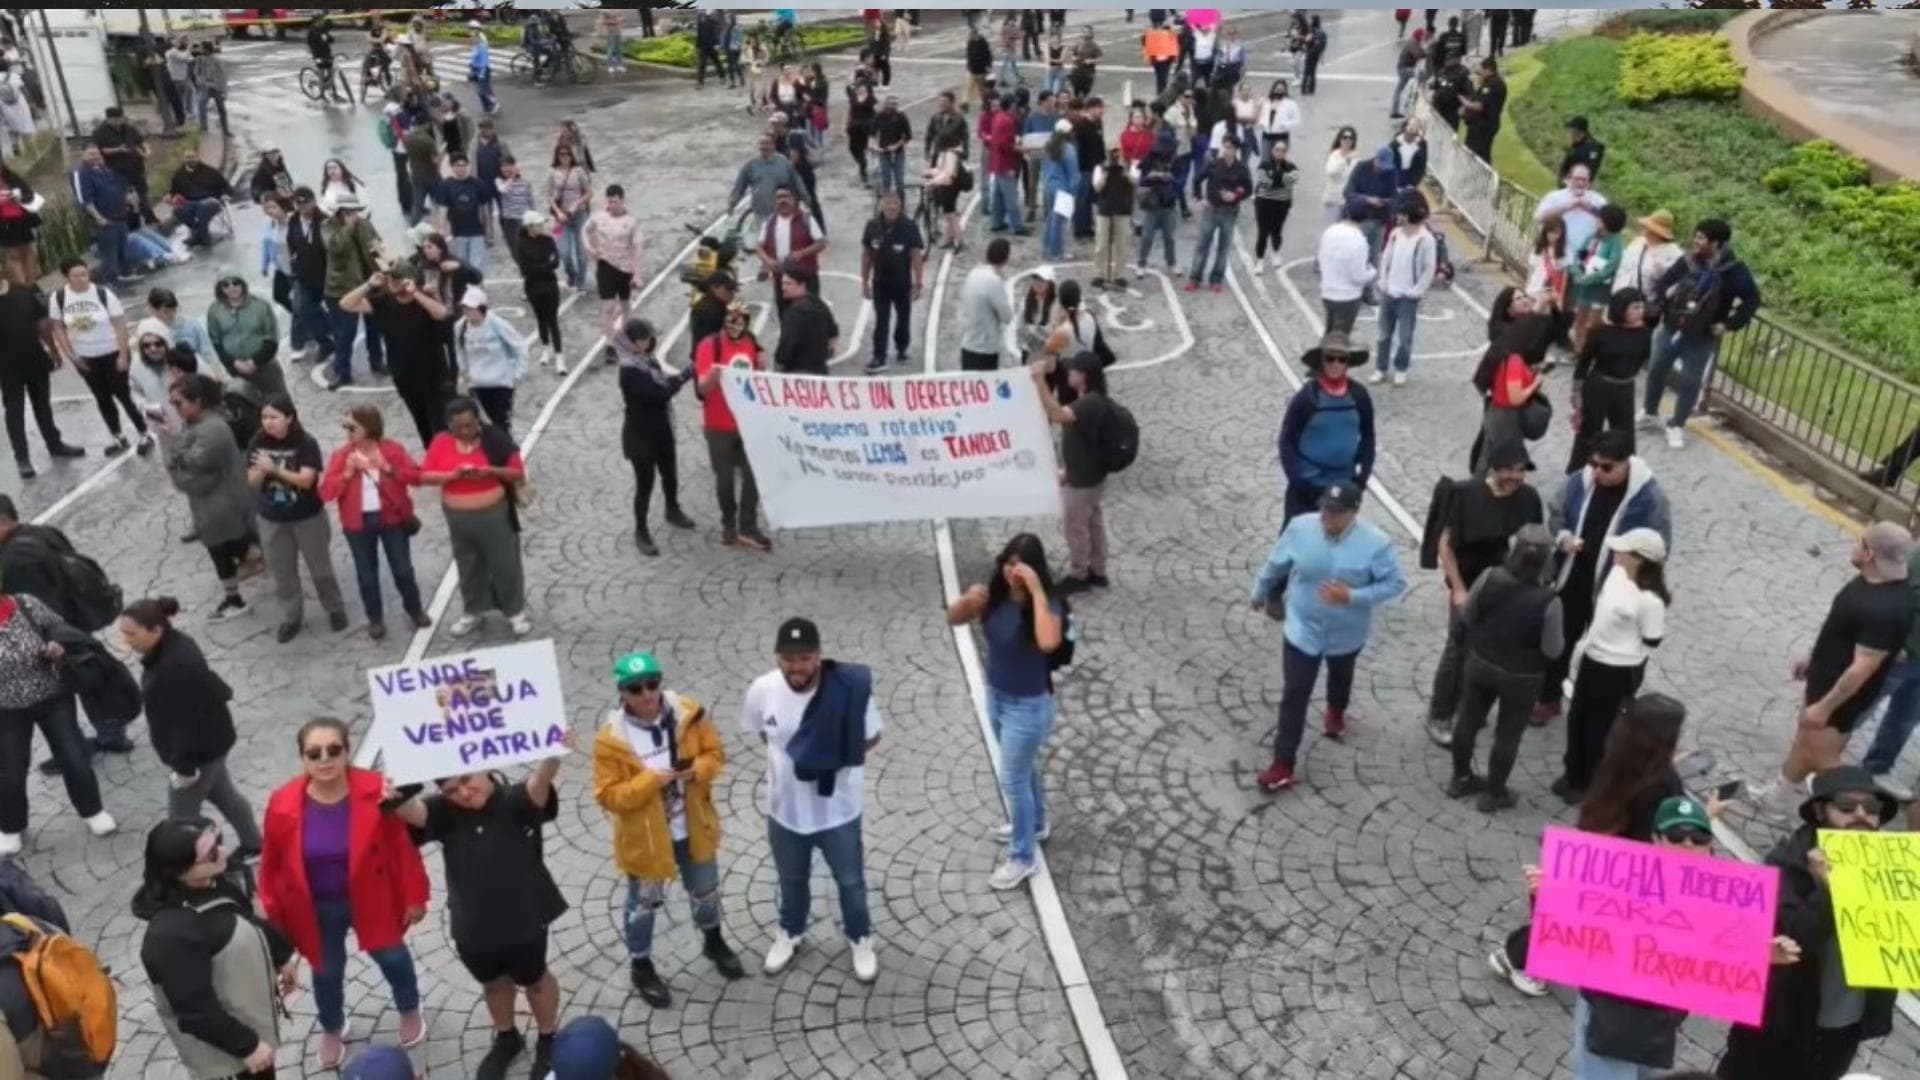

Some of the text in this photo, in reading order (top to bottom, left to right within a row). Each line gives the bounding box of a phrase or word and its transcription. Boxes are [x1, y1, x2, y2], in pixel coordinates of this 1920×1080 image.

[752, 376, 990, 411] EL AGUA ES UN DERECHO
[944, 430, 1011, 459] TANDEO
[374, 658, 483, 695] VENDE
[450, 679, 538, 710] AGUA
[403, 707, 506, 745] VENDE
[459, 723, 564, 765] PATRIA
[1553, 839, 1665, 905] MUCHA
[1577, 890, 1694, 930] PARA
[1840, 905, 1920, 944] AGUA
[1537, 912, 1614, 959] TANTA
